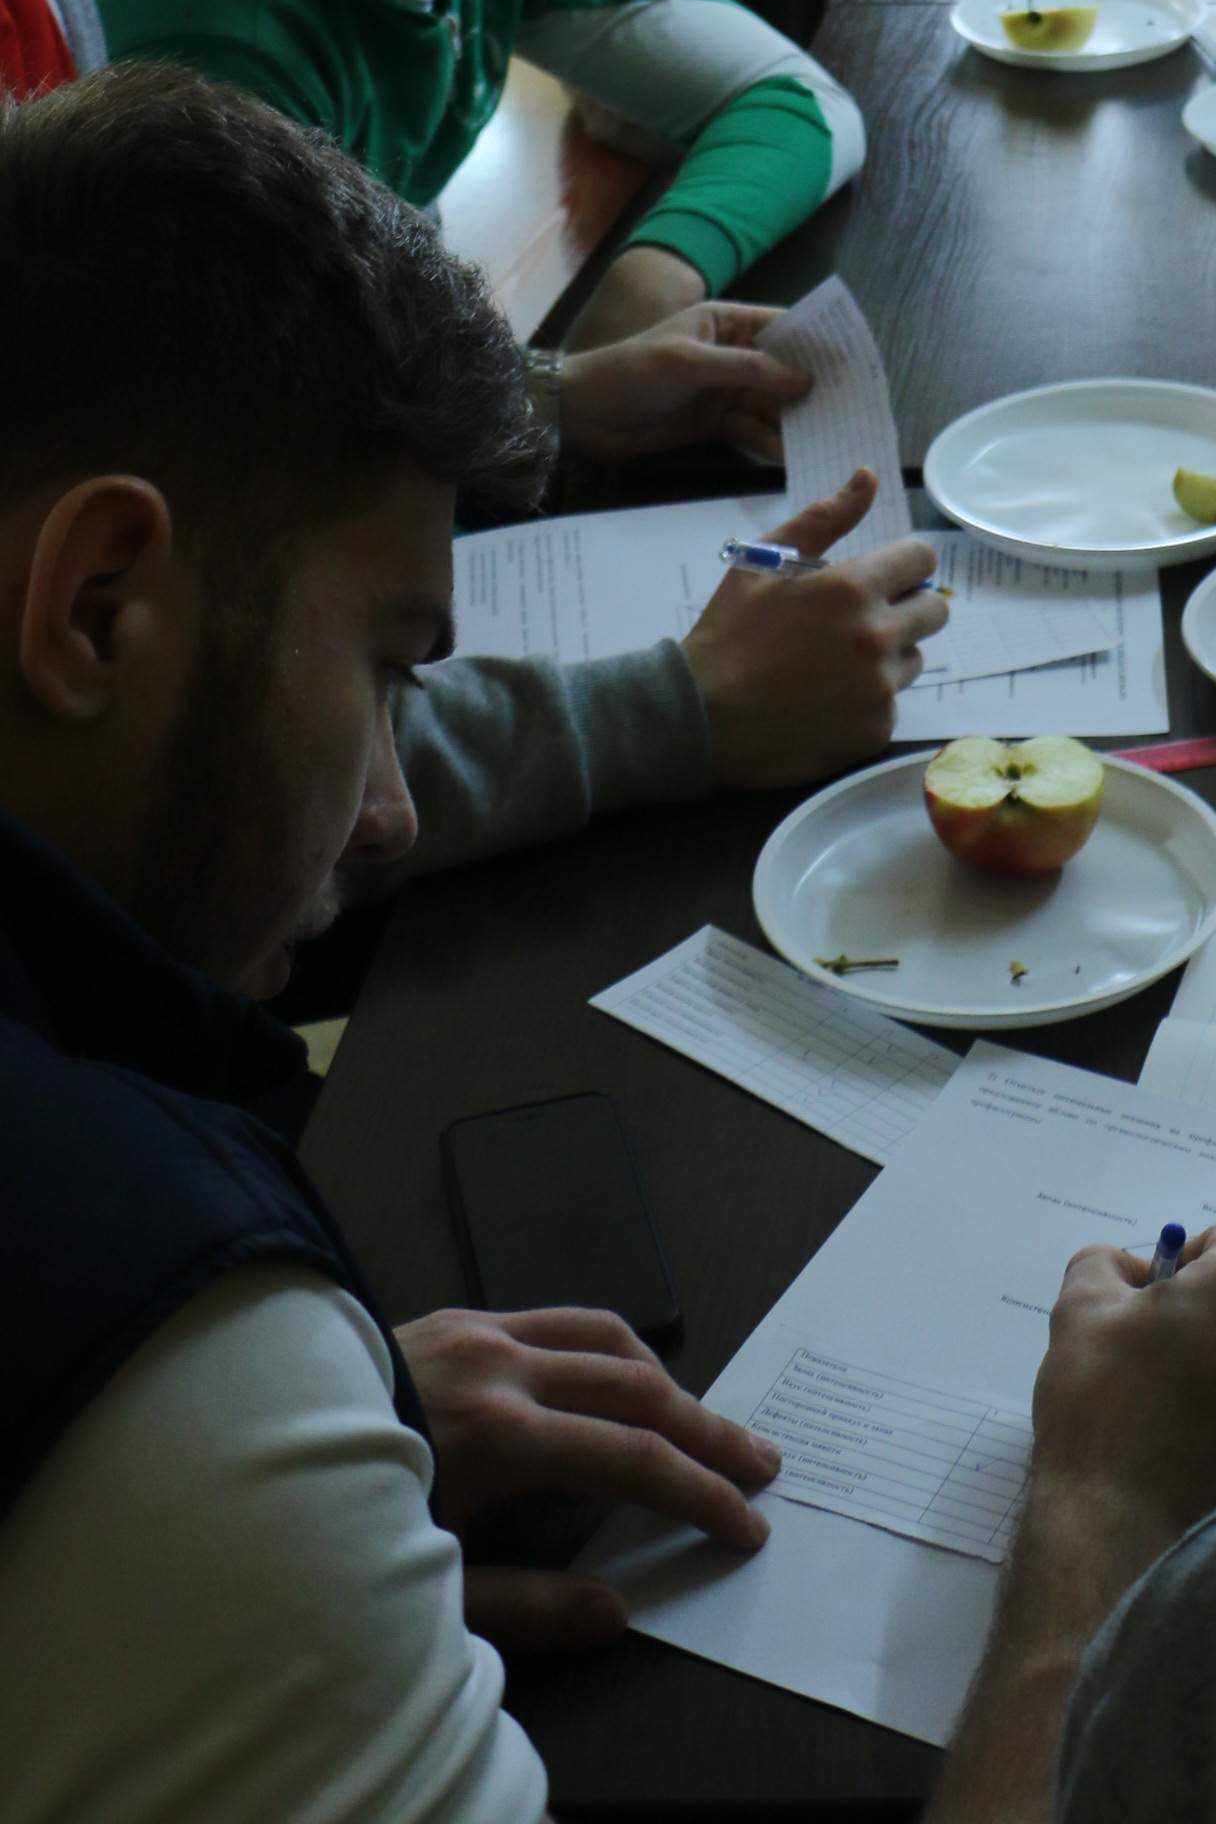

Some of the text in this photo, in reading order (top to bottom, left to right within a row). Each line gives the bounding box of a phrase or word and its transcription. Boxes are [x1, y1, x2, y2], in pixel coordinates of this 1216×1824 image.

[1062, 1200, 1138, 1226] (интенсивность)
[781, 1375, 872, 1413] Вкус (интенсивность)
[815, 1372, 885, 1399] (интенсивность)
[760, 1406, 869, 1447] Дефекты (интенсивность)
